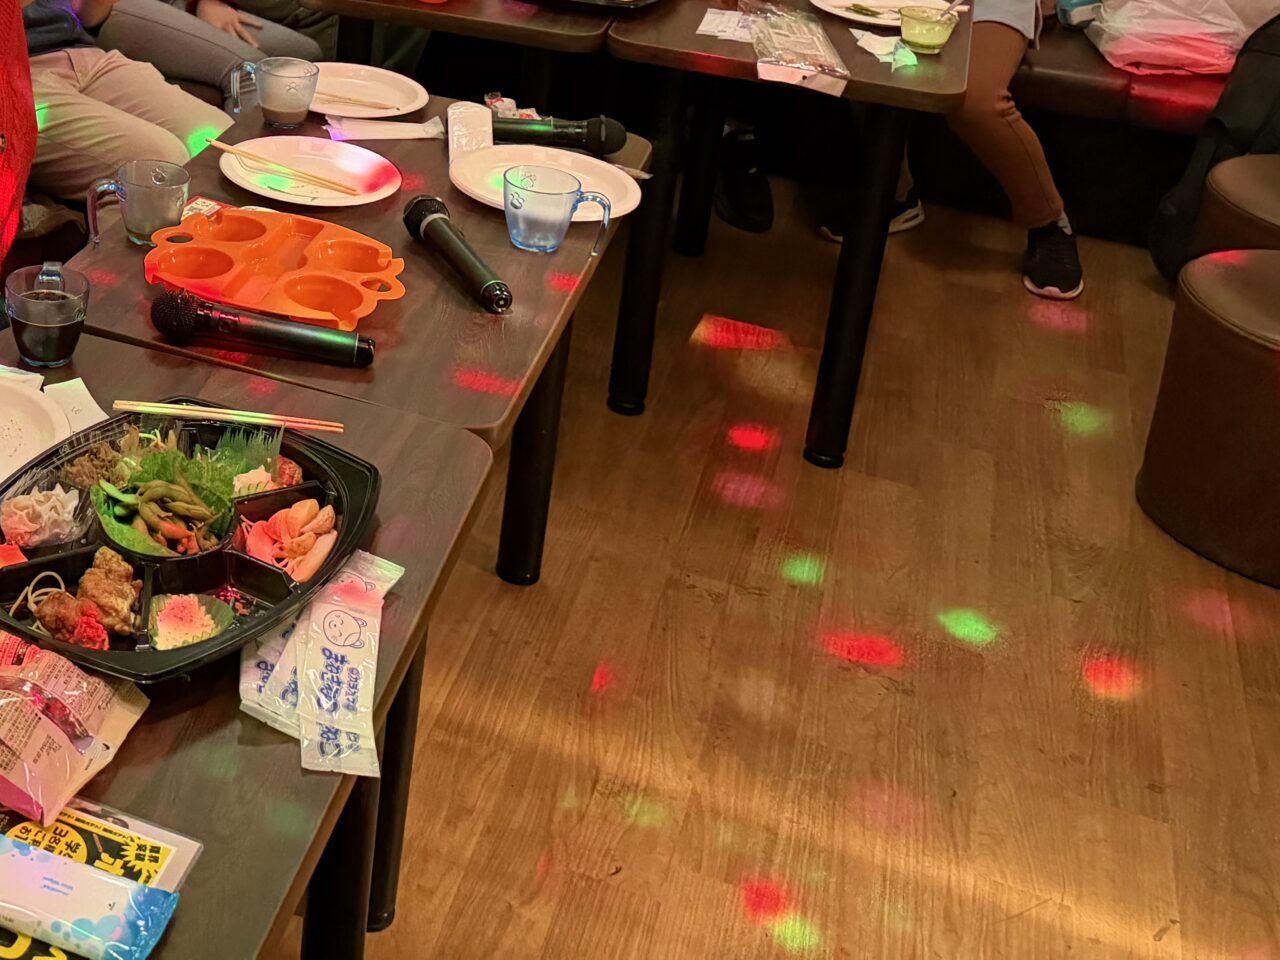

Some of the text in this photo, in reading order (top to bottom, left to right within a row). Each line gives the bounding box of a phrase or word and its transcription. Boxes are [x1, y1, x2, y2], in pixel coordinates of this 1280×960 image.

[317, 647, 347, 712] まねきねこ
